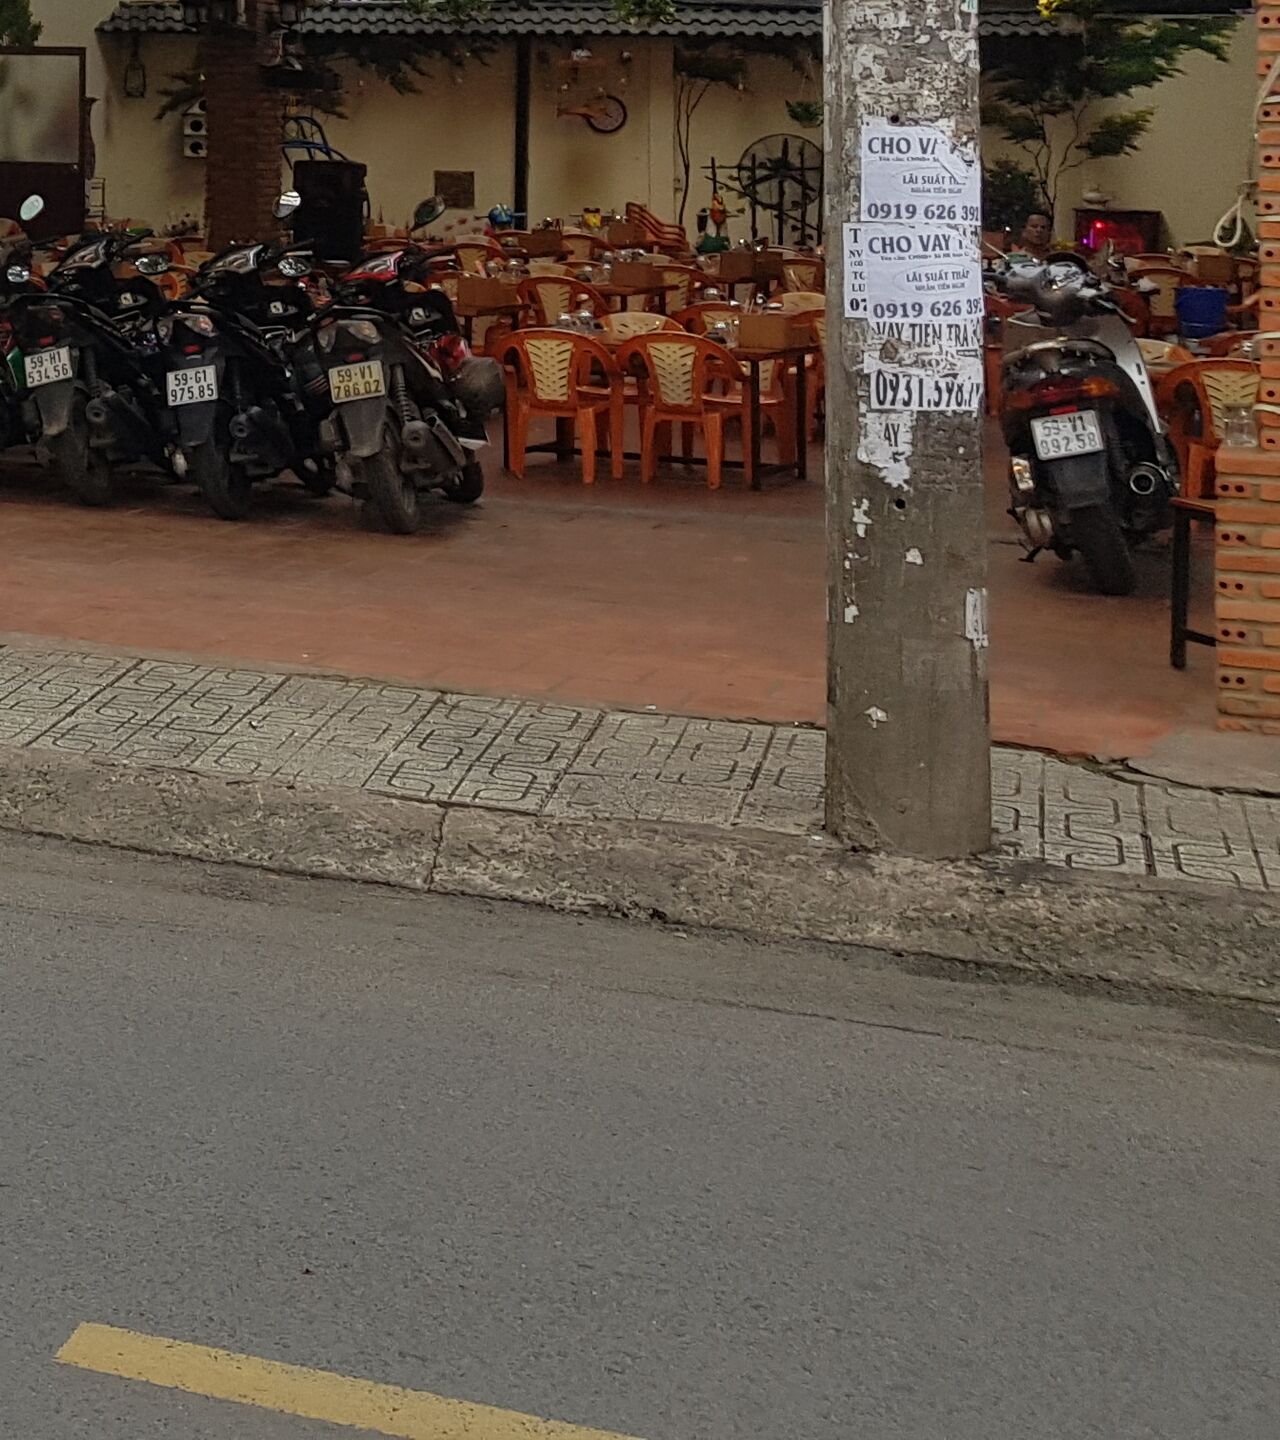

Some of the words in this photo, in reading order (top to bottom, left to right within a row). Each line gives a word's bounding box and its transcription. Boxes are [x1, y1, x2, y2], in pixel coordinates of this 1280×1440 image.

[868, 136, 912, 155] CHO
[867, 202, 918, 220] 0919
[923, 204, 957, 221] 626
[868, 235, 912, 254] CHO
[918, 234, 951, 252] VAY
[873, 301, 924, 319] 0919
[930, 299, 961, 318] 626
[170, 383, 215, 403] 975.85
